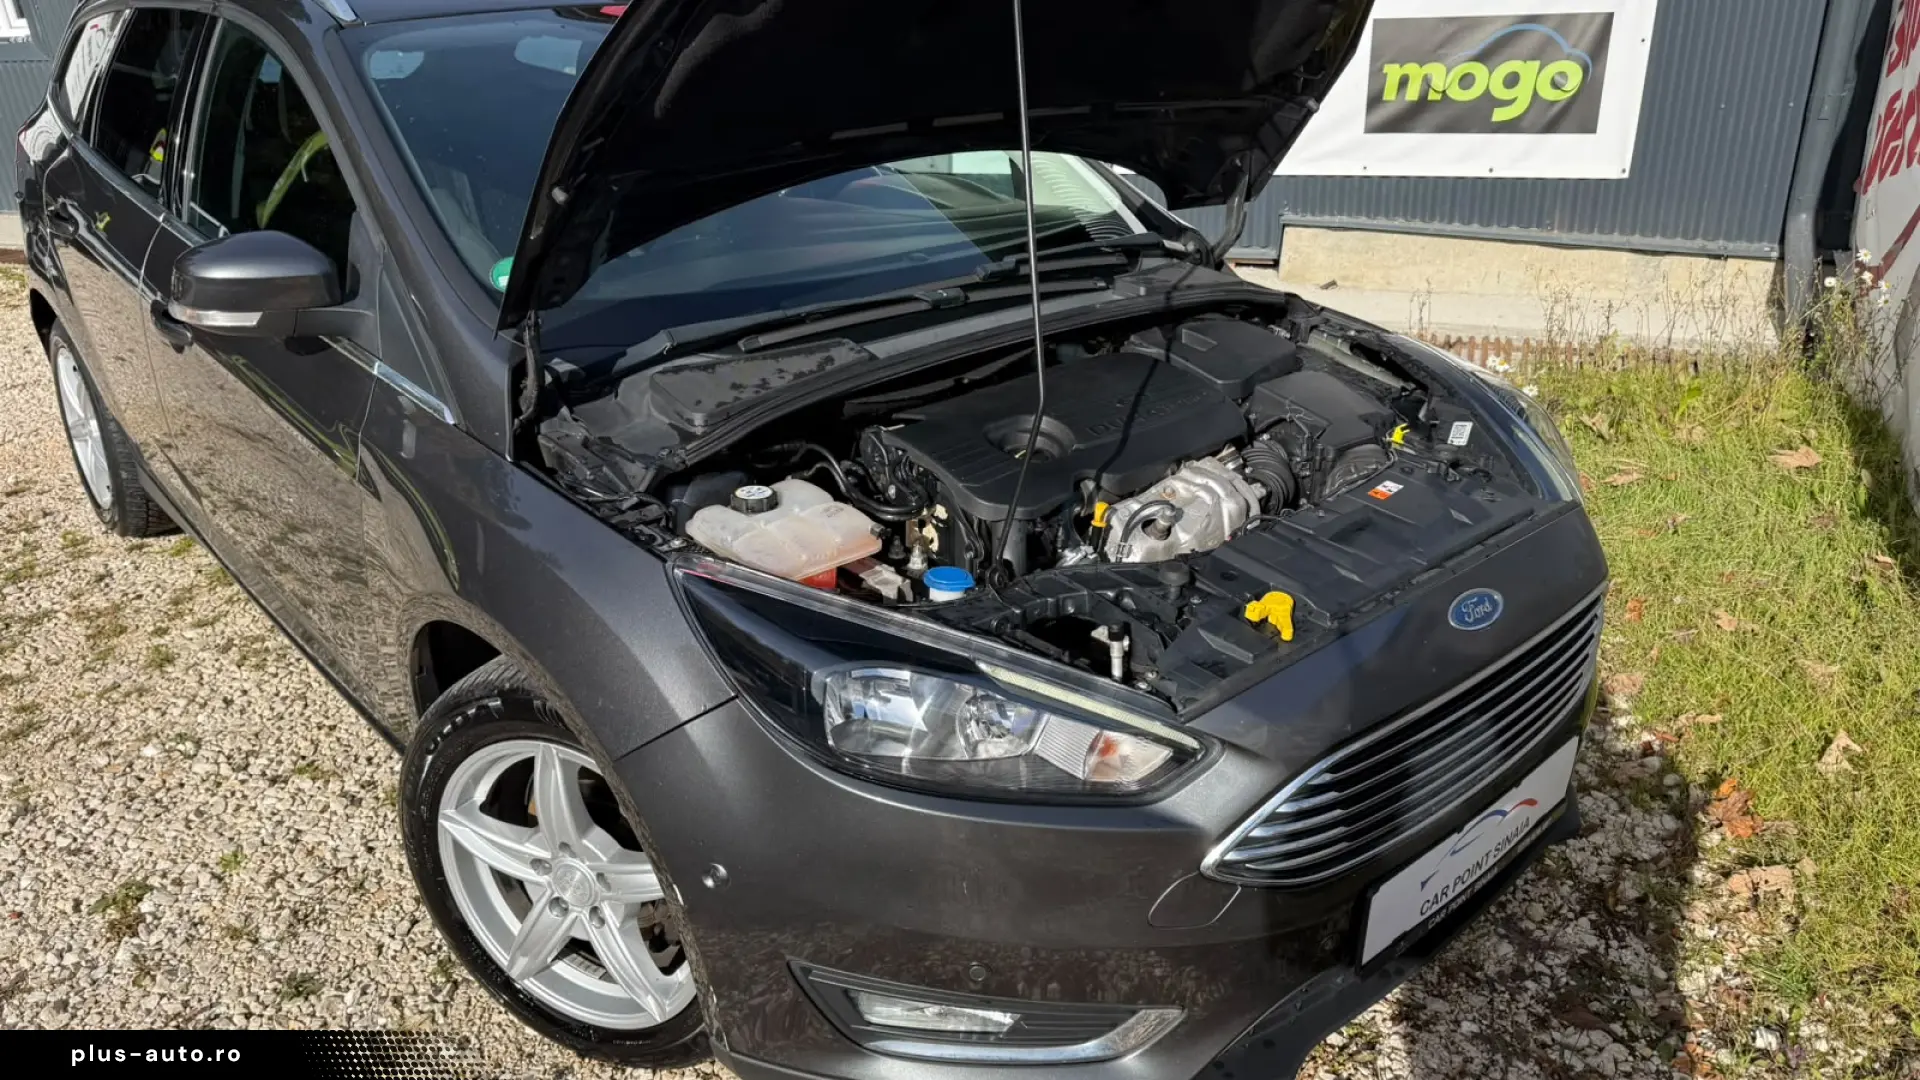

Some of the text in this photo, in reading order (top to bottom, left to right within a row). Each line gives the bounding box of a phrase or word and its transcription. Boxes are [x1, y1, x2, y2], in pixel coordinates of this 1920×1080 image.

[1382, 60, 1584, 122] mogo
[1461, 596, 1493, 623] Ford
[1420, 884, 1450, 916] CAR
[1452, 849, 1493, 893] POINT
[1493, 816, 1531, 858] SINAIA
